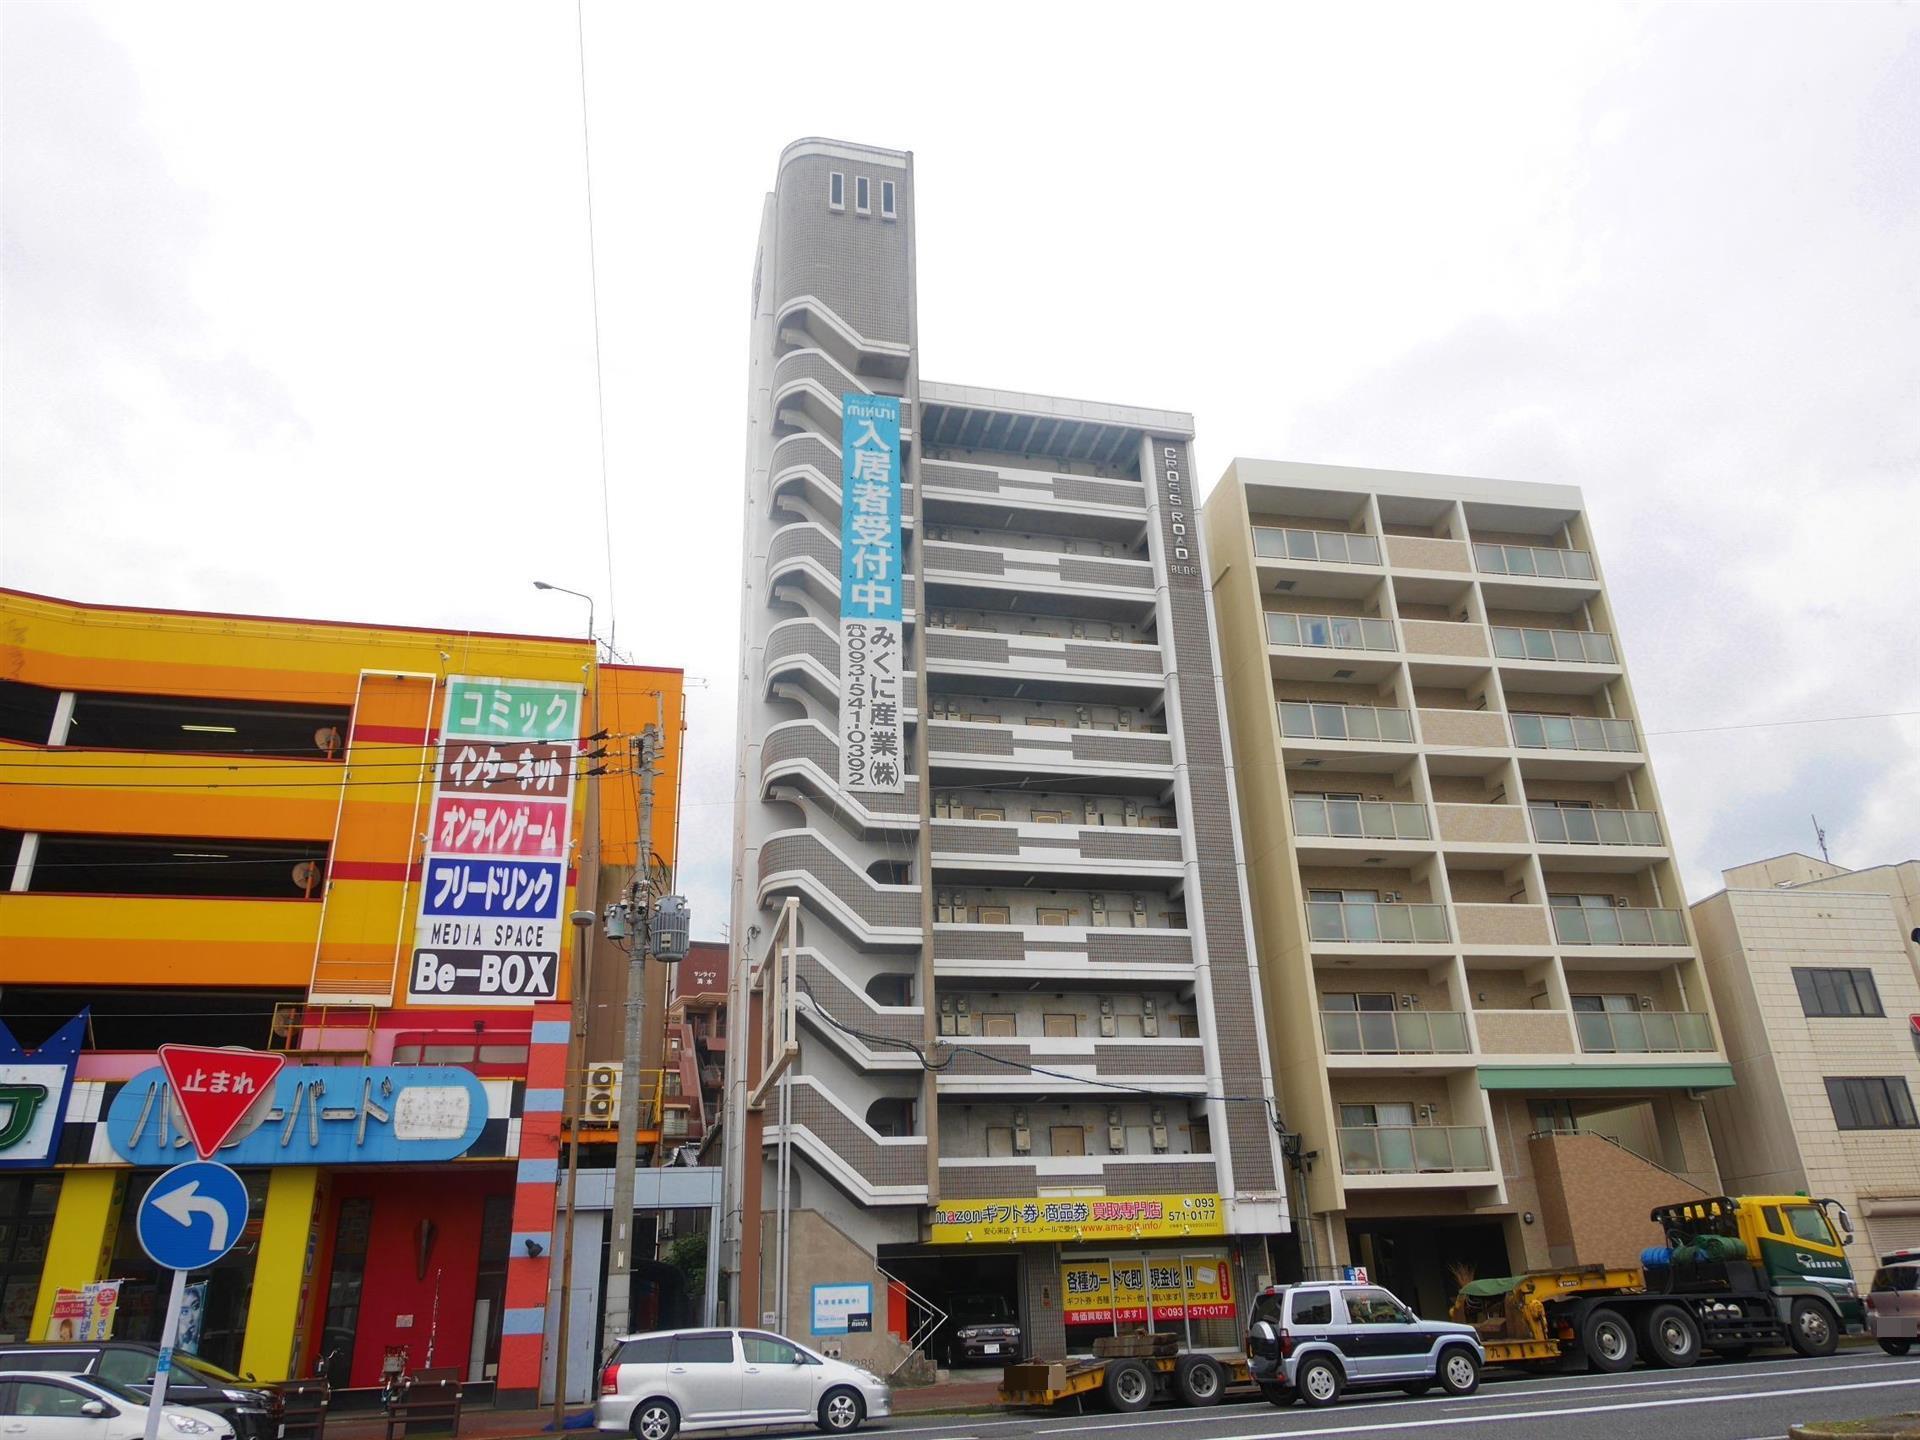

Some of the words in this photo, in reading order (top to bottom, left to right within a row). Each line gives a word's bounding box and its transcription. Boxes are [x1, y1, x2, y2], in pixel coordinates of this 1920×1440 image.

[1164, 447, 1182, 506] CROSS
[851, 419, 893, 614] 入居者受付中
[1171, 511, 1189, 560] ROAD
[459, 689, 568, 733] コミック
[450, 745, 562, 791] インターネット
[440, 804, 557, 851] オンラインゲーム
[434, 865, 553, 913] フリードリンク
[431, 923, 482, 946] MEDIA
[494, 924, 544, 947] SPACE
[415, 953, 552, 994] Be-BOX
[181, 1068, 255, 1094] 止まれ
[128, 1076, 392, 1149] ハーバード
[1092, 1200, 1163, 1222] 買取専門店
[1168, 1210, 1216, 1221] 571-0177
[1195, 1198, 1215, 1208] 093
